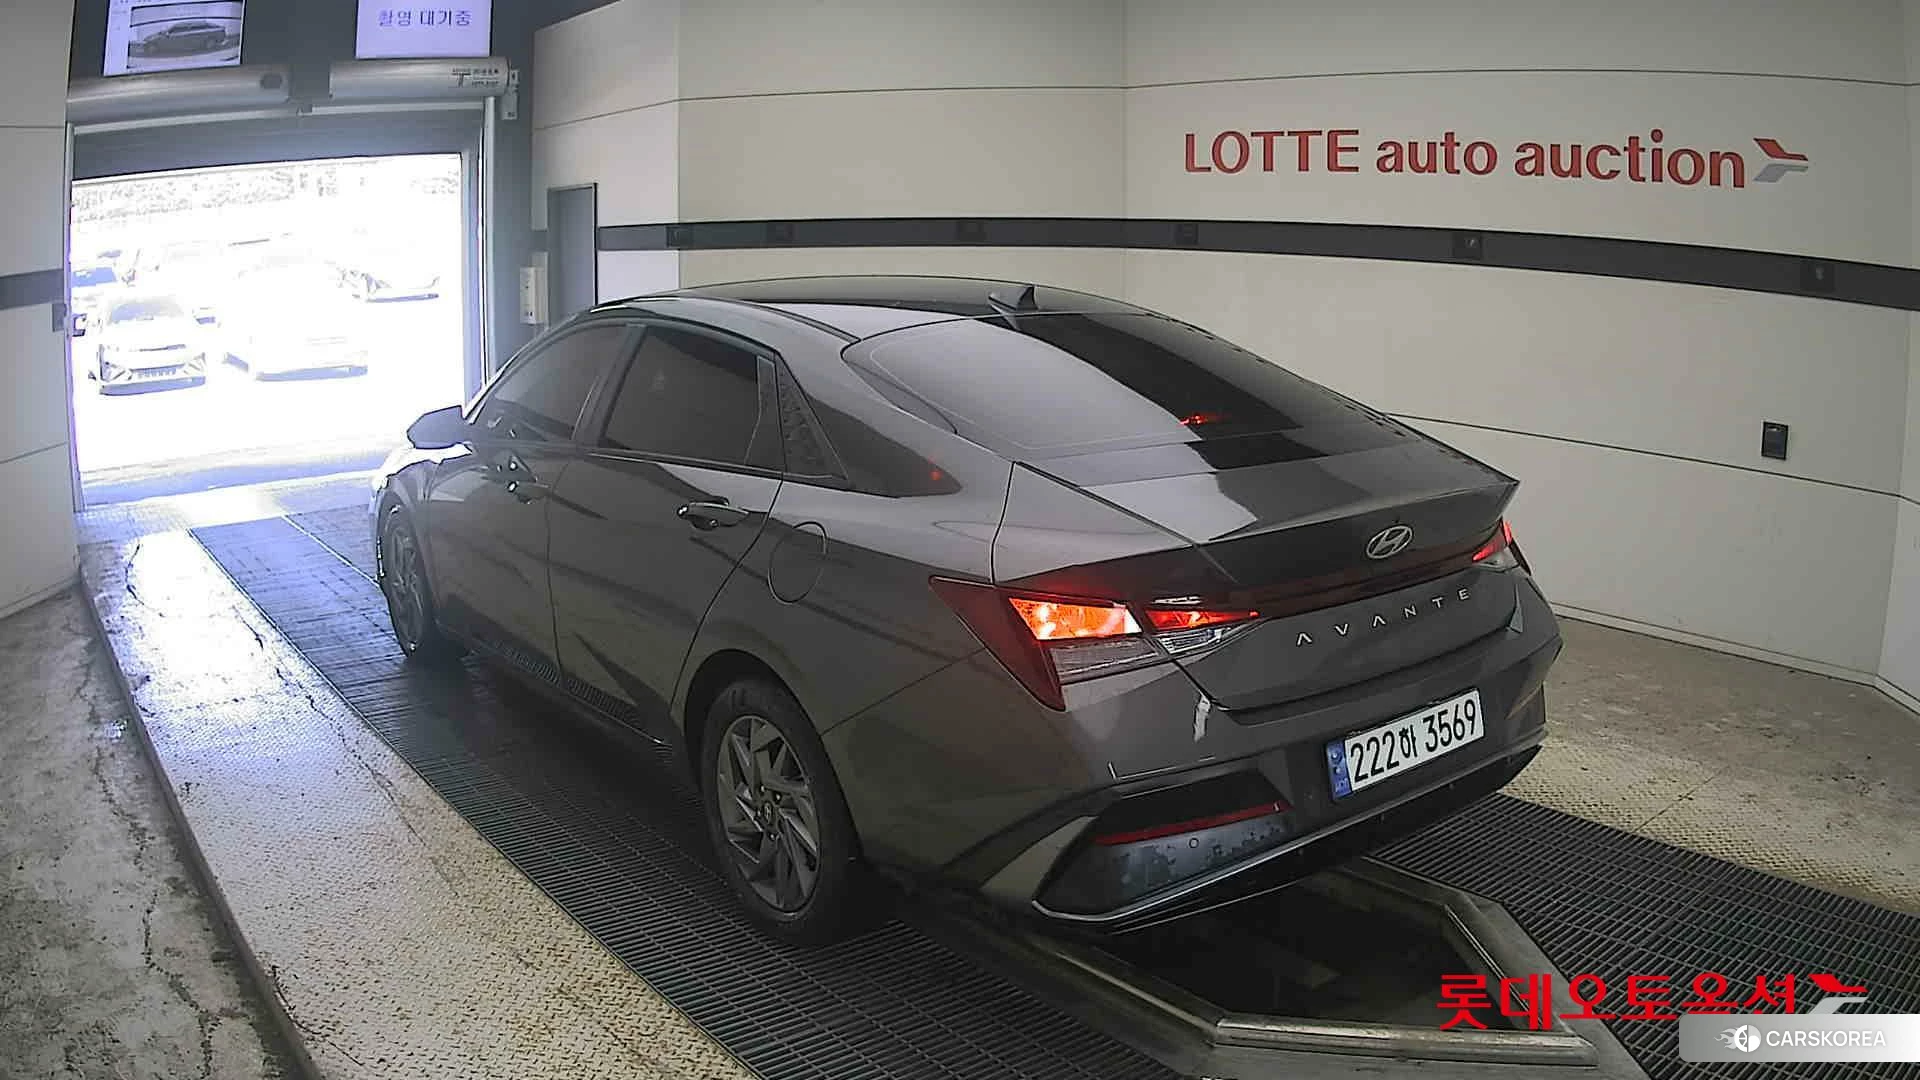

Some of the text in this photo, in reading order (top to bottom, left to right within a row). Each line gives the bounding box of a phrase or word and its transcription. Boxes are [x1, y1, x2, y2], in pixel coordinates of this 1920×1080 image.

[419, 8, 472, 26] 대기중
[1185, 128, 1745, 189] LOTTE auto auction
[1296, 588, 1470, 646] AVANTE
[1350, 699, 1476, 783] 222하 3569
